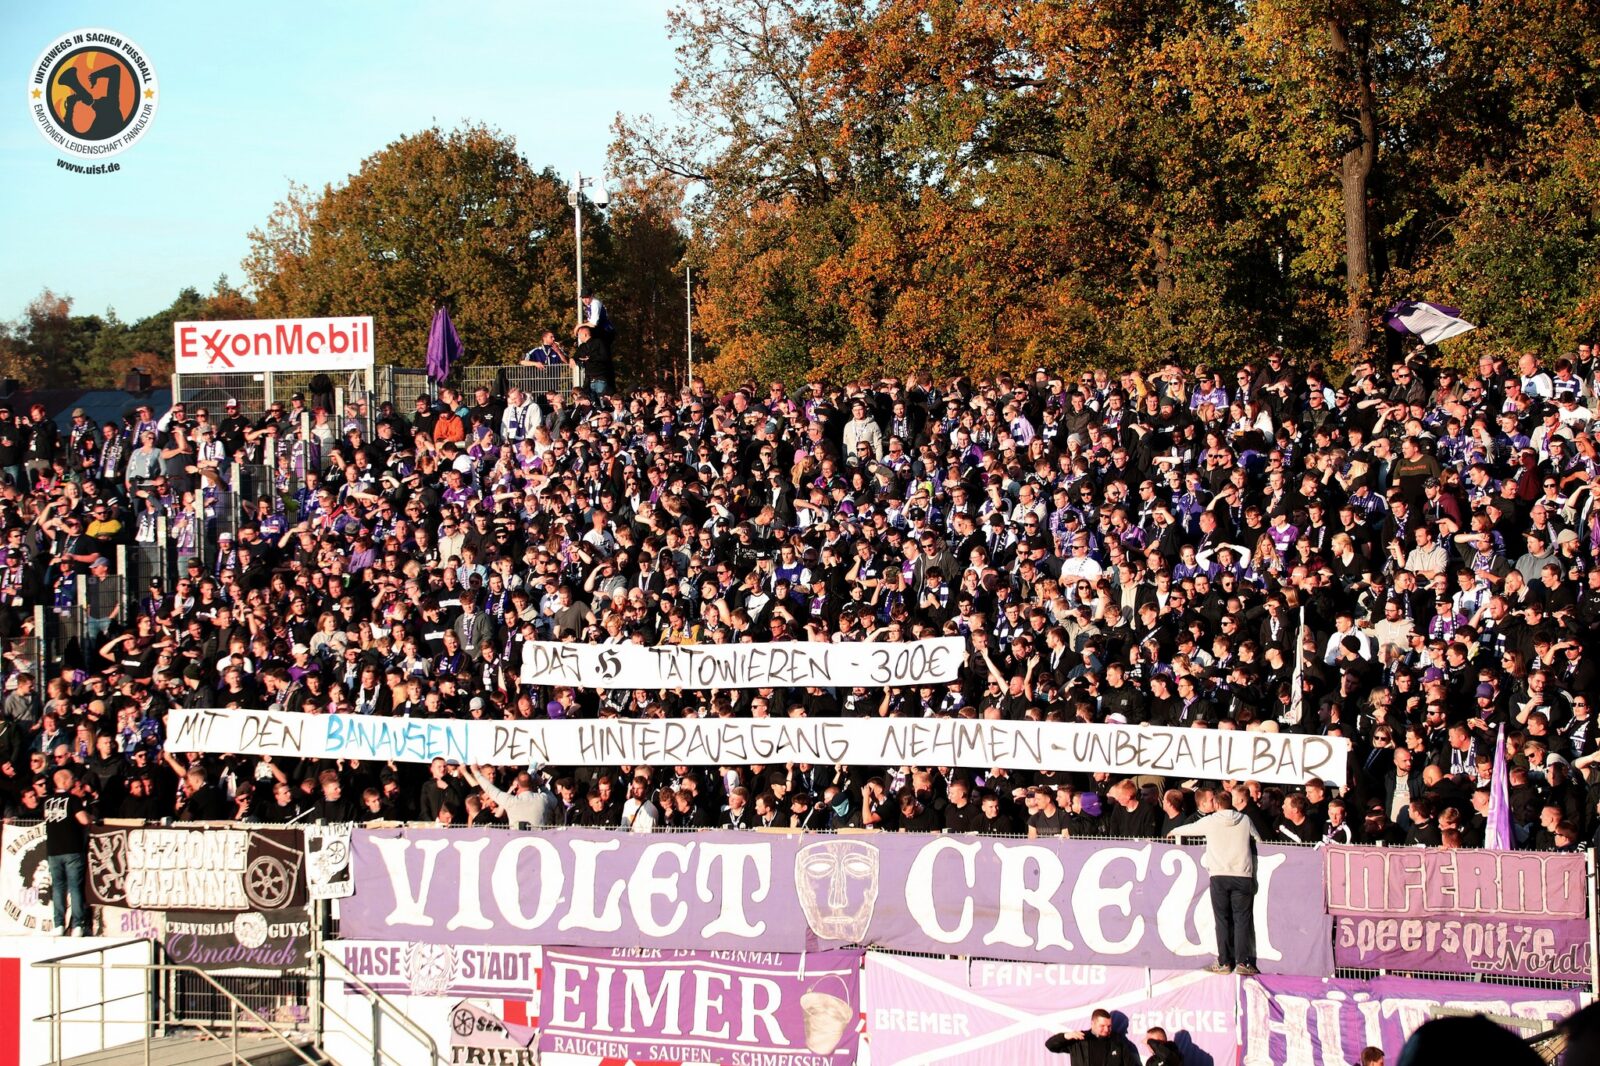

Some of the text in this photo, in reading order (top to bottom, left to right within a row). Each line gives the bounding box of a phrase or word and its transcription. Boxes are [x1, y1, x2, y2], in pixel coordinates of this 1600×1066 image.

[181, 323, 368, 367] ExxonMobil
[532, 645, 582, 682] DAS
[648, 645, 831, 687] TÄTOWIEREN
[870, 646, 951, 684] 300€
[175, 710, 230, 749] MIT
[238, 715, 304, 752] DEN
[325, 714, 469, 762] BANAUSEN
[492, 725, 551, 763] DEN
[578, 720, 848, 763] HINTERAUSGANG
[880, 722, 1041, 766] NEHMEN
[1073, 729, 1336, 781] UNBEZAHLBAR
[128, 829, 249, 871] SEZIONE
[368, 835, 772, 938] VIOLET
[165, 921, 233, 936] CERVISIAM
[268, 921, 308, 938] GUYS
[166, 933, 297, 965] Osnabrück
[344, 947, 531, 980] HASE STADT
[982, 964, 1107, 986] FAN-CLUB
[549, 961, 791, 1046] EIMER
[875, 1008, 970, 1036] BREMER
[452, 1046, 536, 1066] TRIER
[554, 1036, 629, 1058] RAUCHEN
[649, 1045, 711, 1063] SAUFEN
